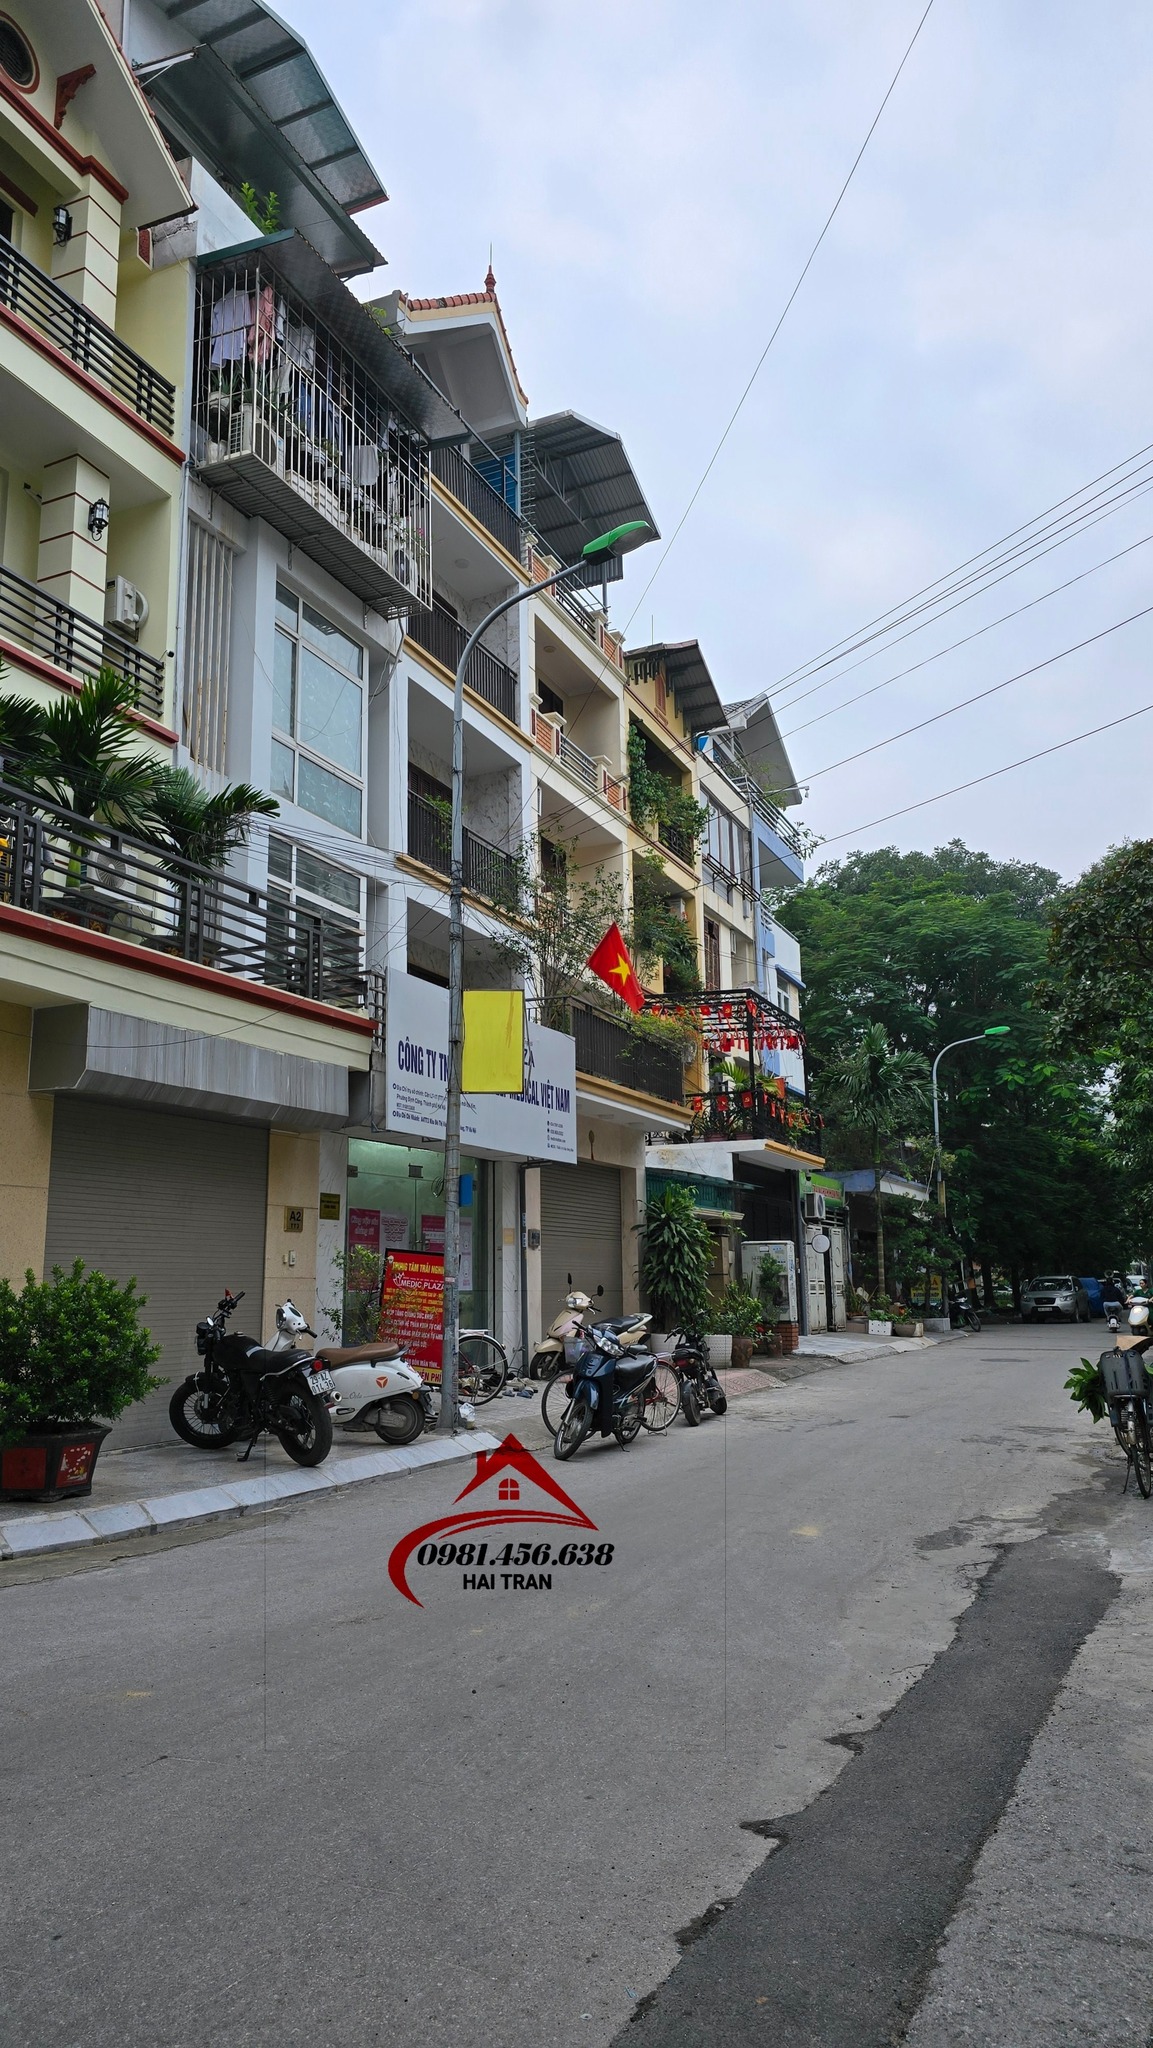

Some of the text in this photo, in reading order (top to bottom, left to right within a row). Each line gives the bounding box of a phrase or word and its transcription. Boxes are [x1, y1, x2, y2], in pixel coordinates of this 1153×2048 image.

[398, 1036, 424, 1075] CÔNG
[426, 1049, 437, 1079] TY
[540, 1079, 554, 1114] VIỆT
[555, 1087, 570, 1114] NAM
[290, 1210, 302, 1221] A2
[401, 1279, 422, 1289] MEDIC
